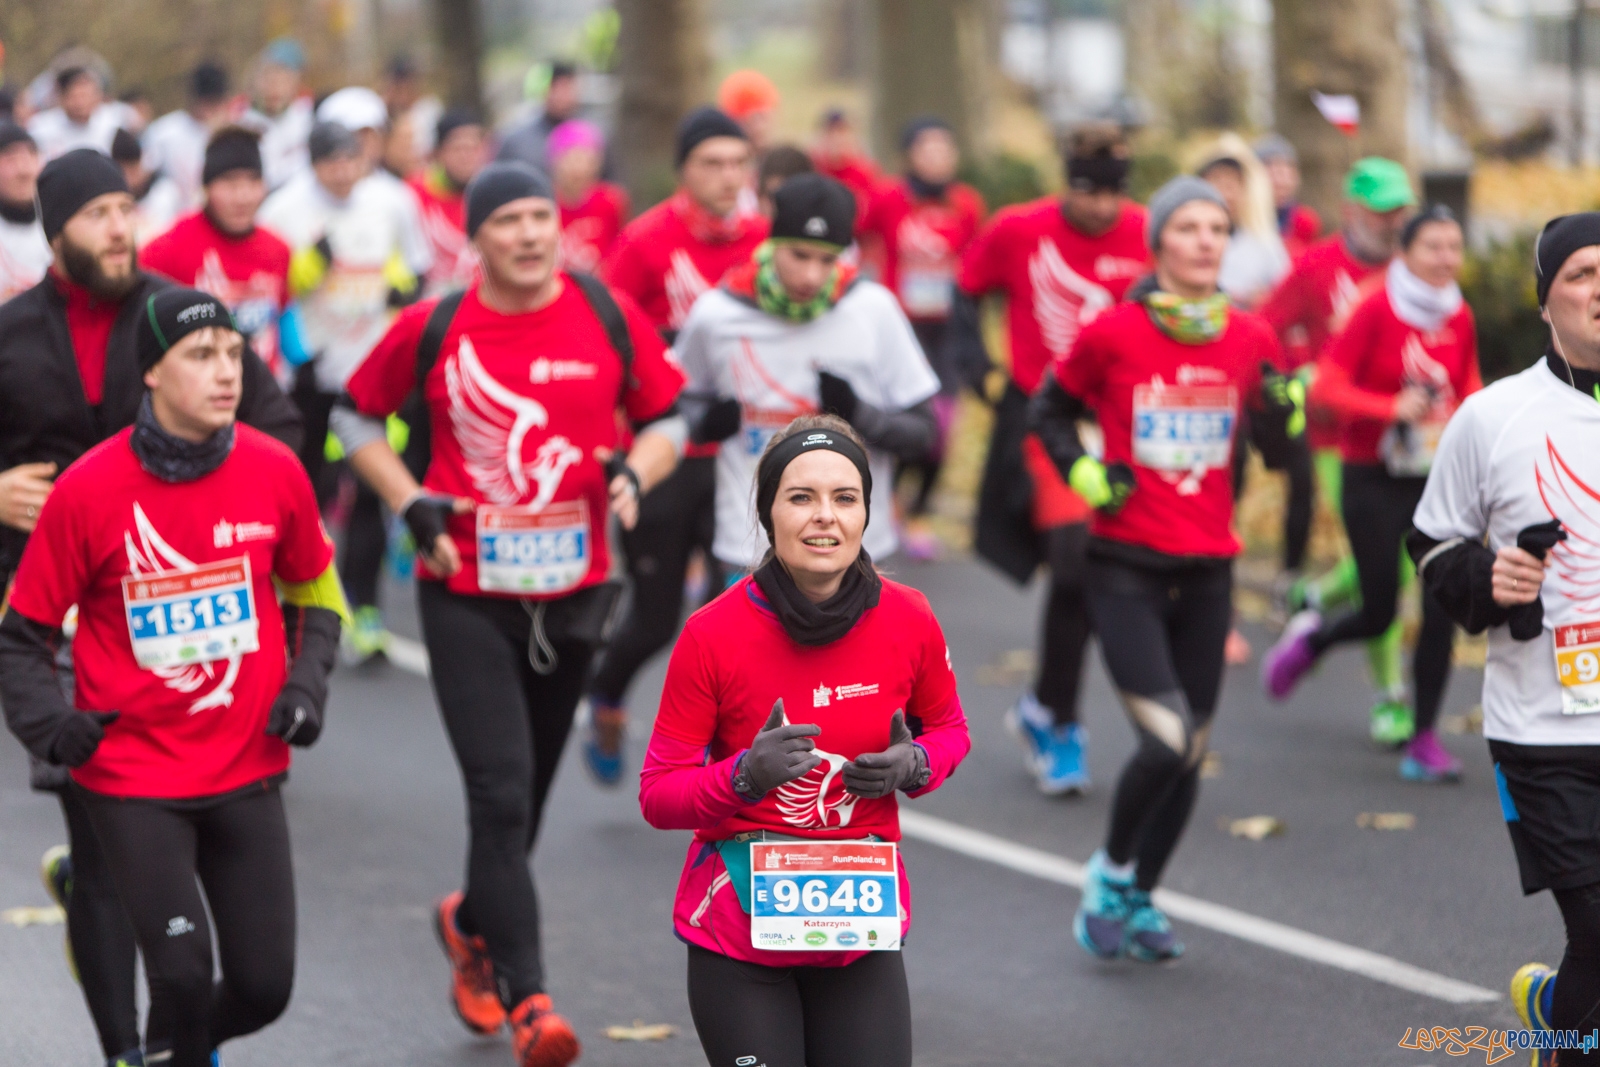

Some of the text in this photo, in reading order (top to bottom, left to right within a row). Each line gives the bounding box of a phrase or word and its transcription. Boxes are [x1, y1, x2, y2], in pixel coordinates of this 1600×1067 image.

[146, 592, 242, 636] 1513
[1575, 651, 1600, 682] 9
[832, 855, 886, 866] RunPoland.org
[757, 879, 883, 913] E 9648
[803, 920, 851, 929] Katarzyna
